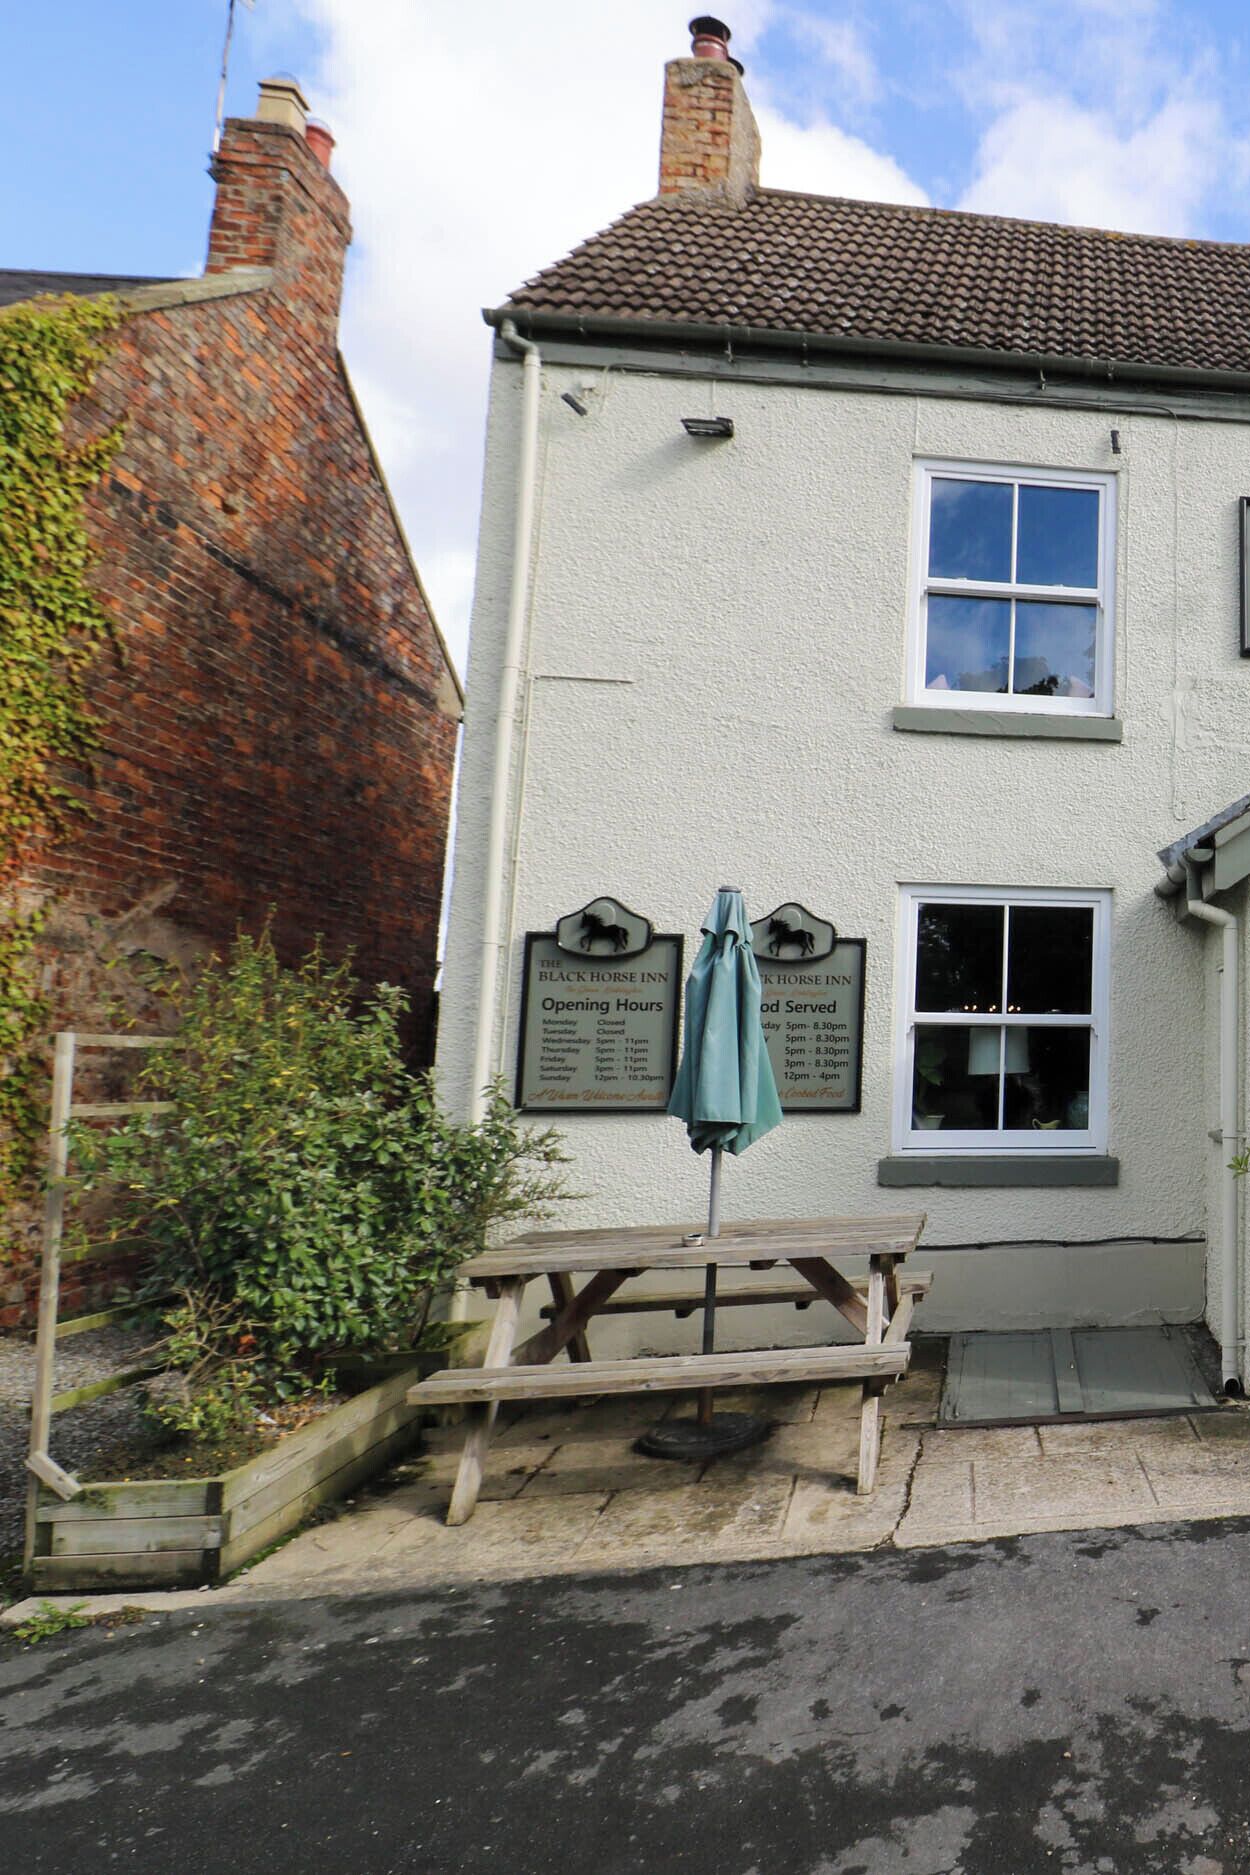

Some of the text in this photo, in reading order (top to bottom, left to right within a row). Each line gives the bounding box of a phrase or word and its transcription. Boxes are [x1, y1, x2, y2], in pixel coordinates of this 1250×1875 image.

[540, 960, 562, 969] THE
[539, 971, 669, 983] BLACK HORSE INN
[777, 974, 821, 985] HORSE
[825, 975, 852, 985] INN
[542, 997, 664, 1014] Opening Hours
[760, 1000, 837, 1013] od Served
[542, 1019, 577, 1027] Monday
[813, 1022, 847, 1032] 8.30pm
[543, 1028, 576, 1036] Tuesday
[542, 1037, 592, 1045] Wednesday
[785, 1034, 806, 1043] 5pm
[816, 1034, 849, 1043] 8.30pm
[785, 1046, 805, 1056] 5pm
[815, 1046, 849, 1056] 8.30pm
[784, 1059, 805, 1069] 3pm
[814, 1059, 848, 1069] 8.30pm
[540, 1074, 571, 1082] Sunday
[784, 1071, 810, 1082] 12pm
[819, 1072, 840, 1082] 4pm
